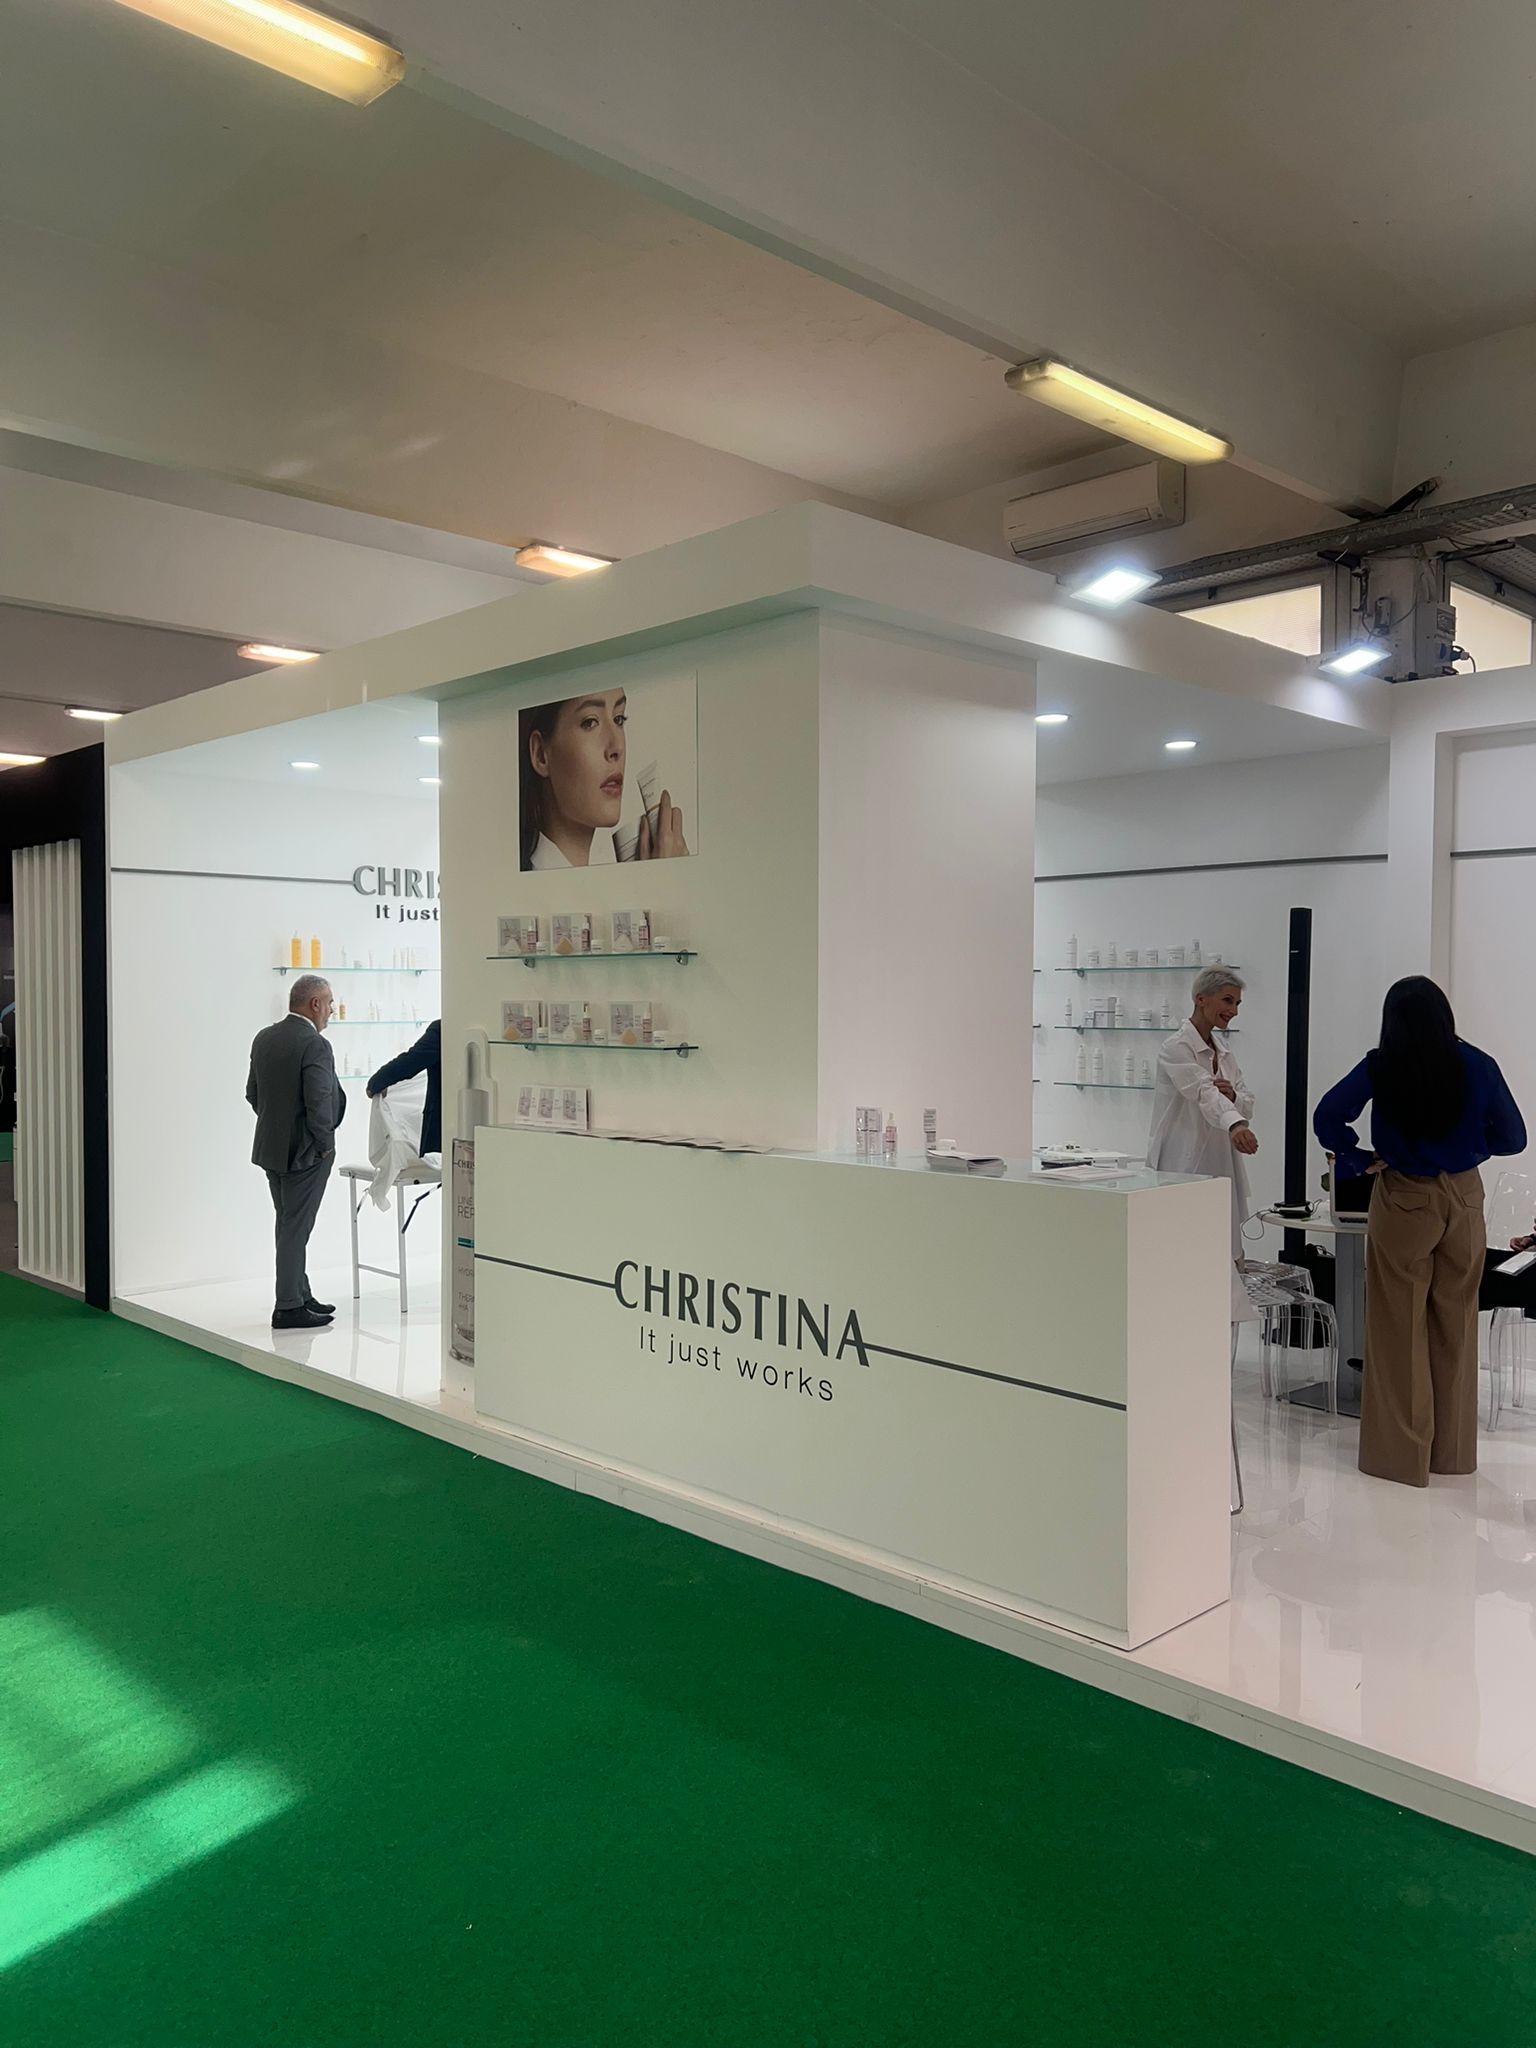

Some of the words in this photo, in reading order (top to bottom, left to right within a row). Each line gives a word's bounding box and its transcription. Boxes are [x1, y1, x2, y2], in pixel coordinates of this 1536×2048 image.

[353, 865, 440, 899] CHRI
[376, 904, 390, 918] It
[399, 904, 439, 923] just
[614, 1260, 870, 1367] CHRISTINA
[640, 1326, 656, 1353] It
[668, 1333, 721, 1371] just
[737, 1357, 834, 1402] works
